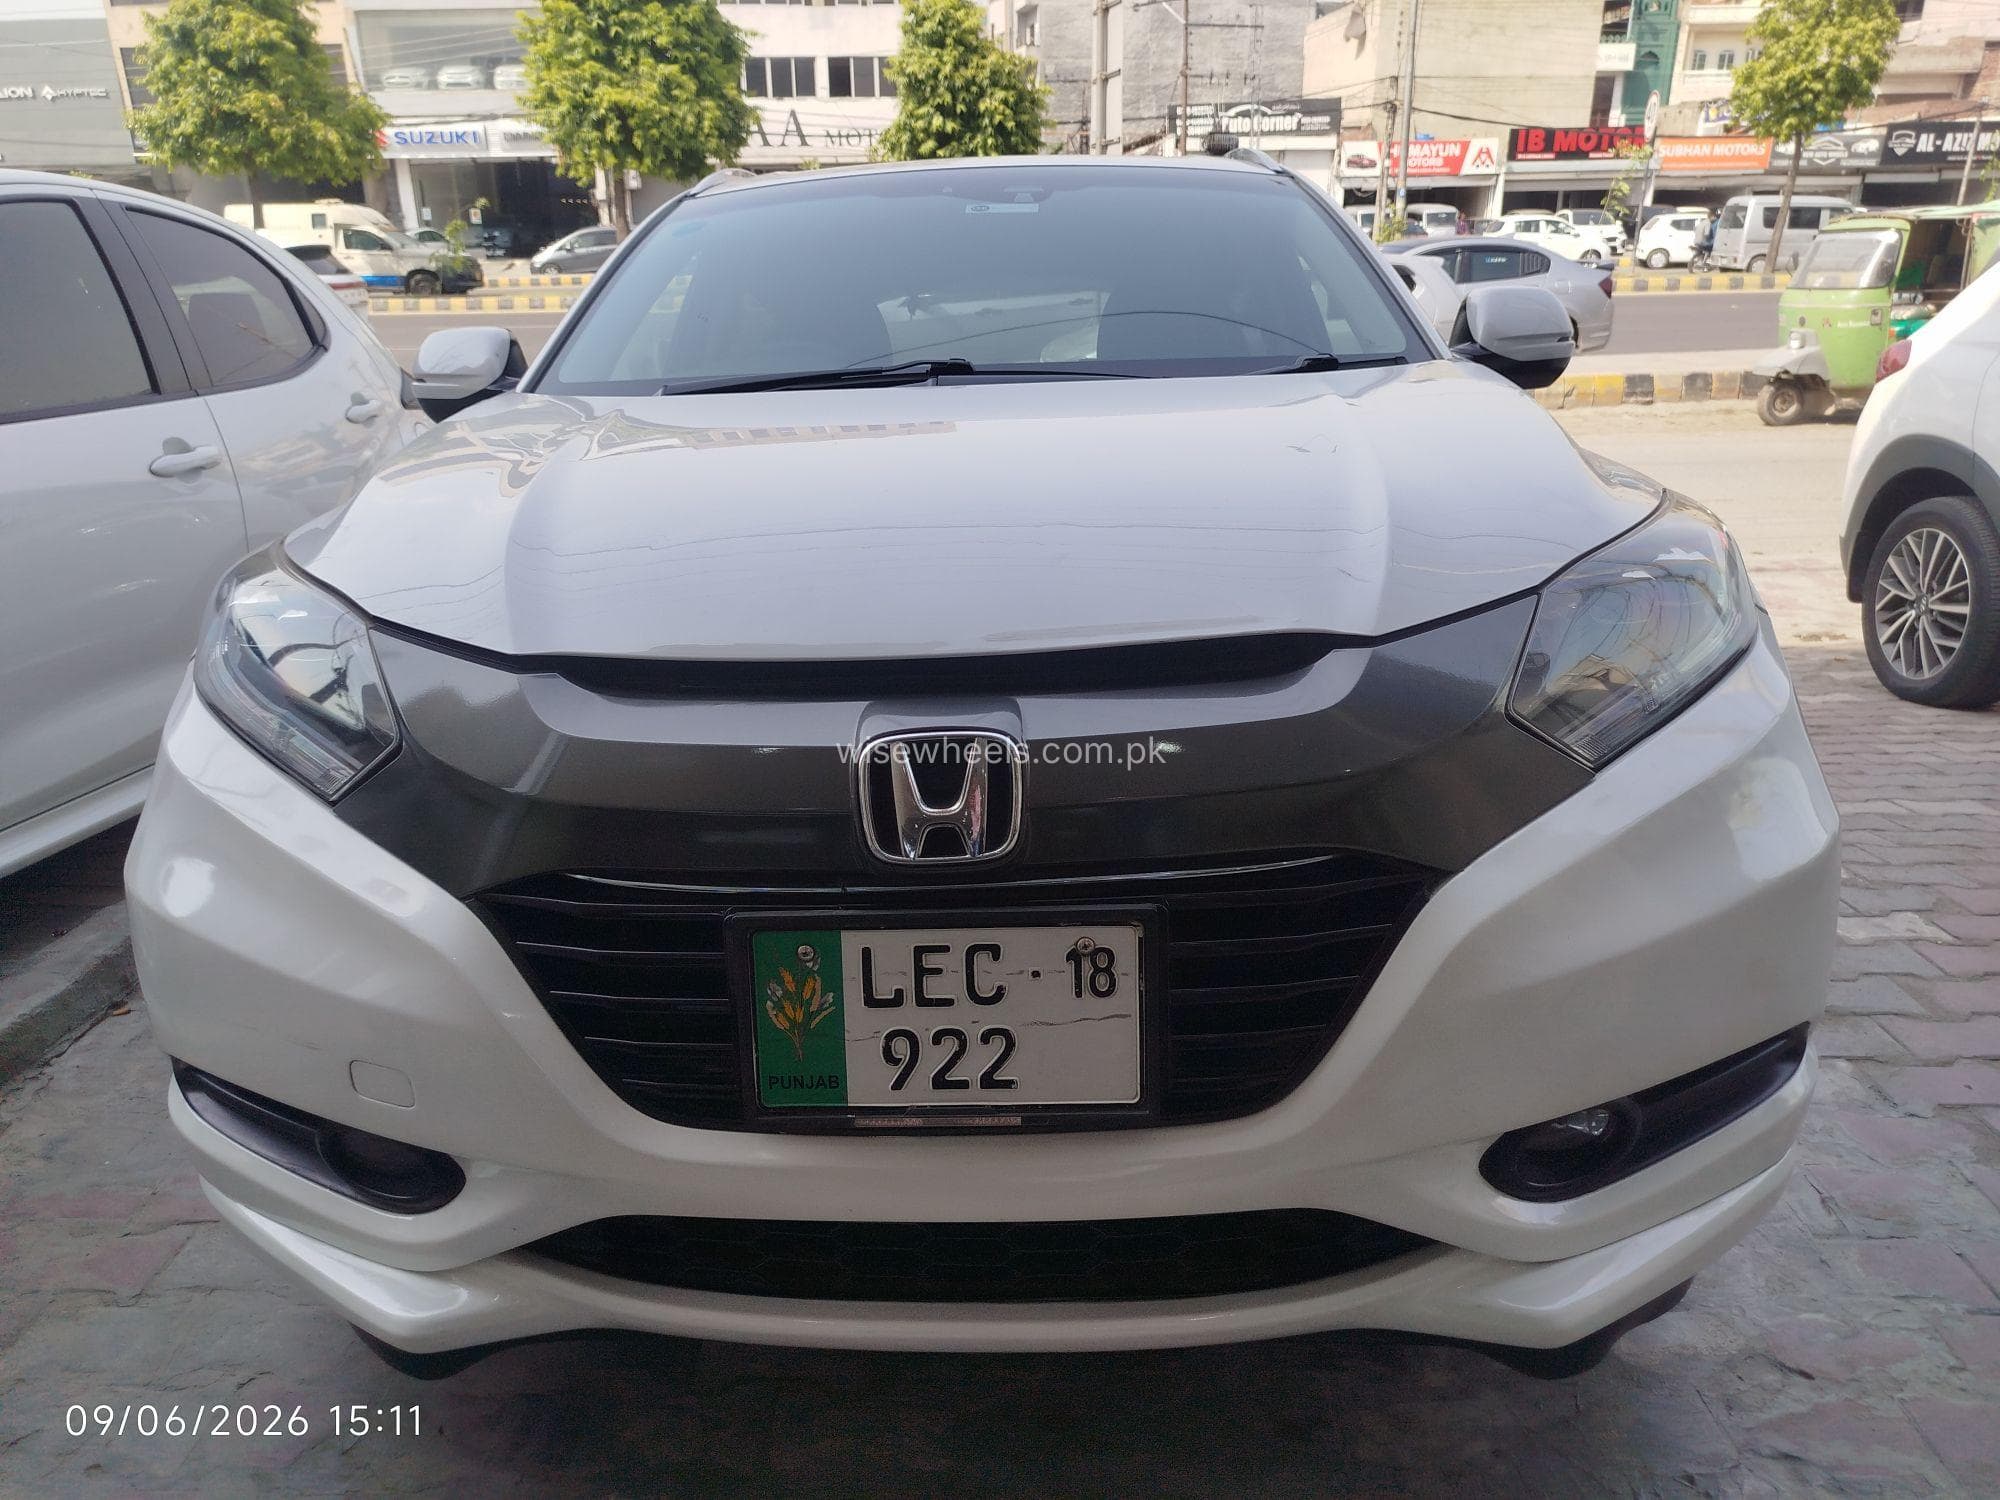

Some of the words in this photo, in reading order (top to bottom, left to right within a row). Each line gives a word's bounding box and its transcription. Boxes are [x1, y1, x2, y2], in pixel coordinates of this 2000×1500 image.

[394, 131, 479, 145] SUZUKI
[1516, 129, 1546, 153] IB
[1552, 127, 1646, 152] MOTOR
[1388, 142, 1461, 158] HMAYUN
[1659, 143, 1712, 158] SUBHAN
[1712, 142, 1767, 157] MOTORS
[1407, 157, 1445, 168] OTORS
[861, 944, 1007, 1008] LEC
[1065, 946, 1118, 999] 18
[881, 1026, 1018, 1091] 922
[768, 1073, 840, 1090] PUNJAB
